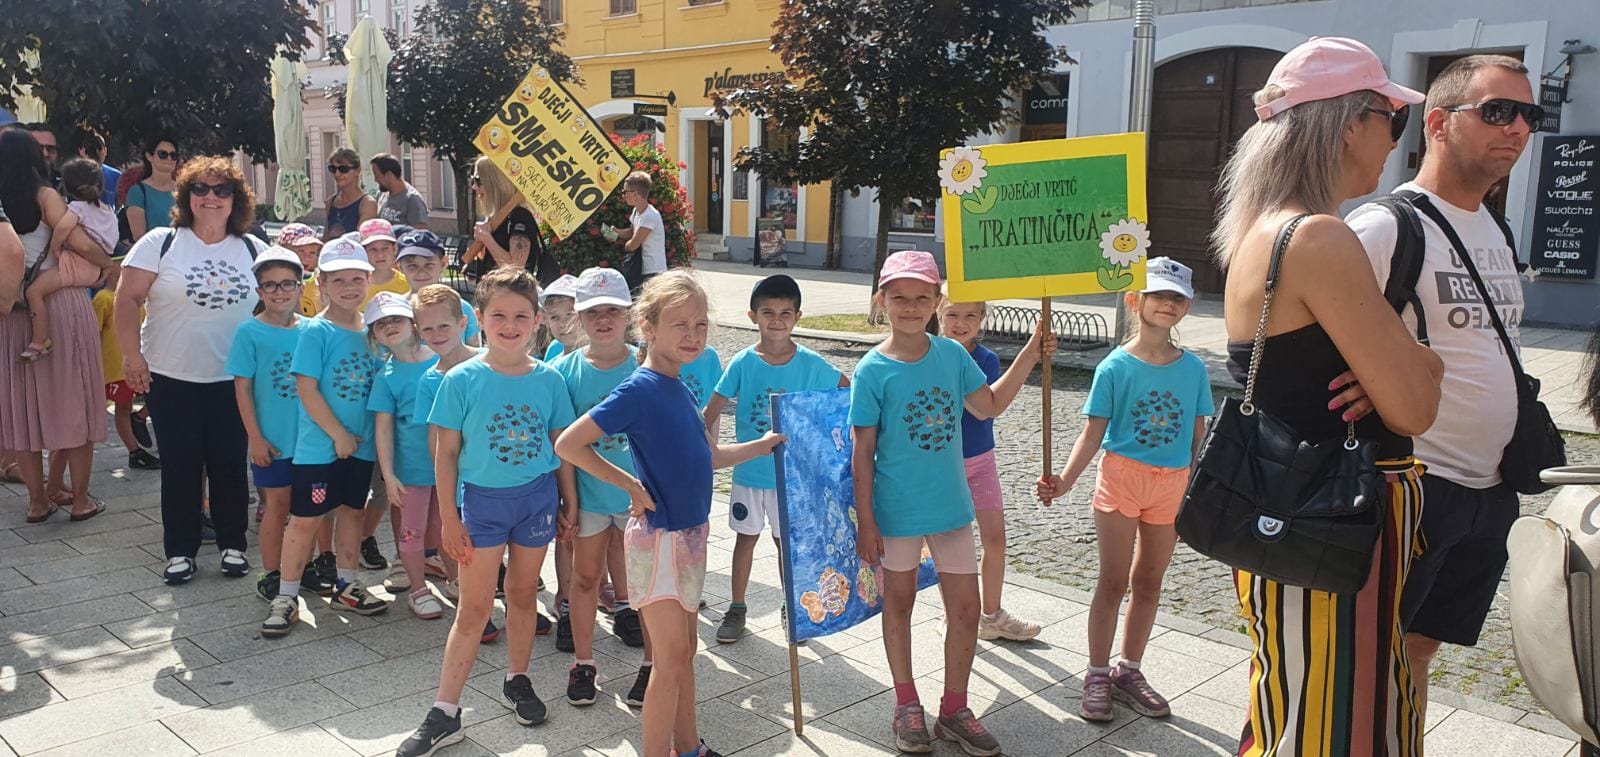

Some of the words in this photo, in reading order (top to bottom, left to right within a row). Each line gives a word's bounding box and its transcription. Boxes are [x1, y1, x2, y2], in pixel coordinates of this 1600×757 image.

[538, 86, 573, 124] DJEČJI
[578, 130, 613, 165] VRTIĆ
[497, 101, 604, 212] SMJEŠKO
[1555, 139, 1595, 158] Ray-Ban
[1555, 170, 1588, 188] Persol
[524, 166, 547, 191] SVETI
[548, 191, 575, 225] MARTIN
[1000, 179, 1040, 202] DJEČJI
[1044, 175, 1078, 197] VRTIĆ
[1547, 190, 1594, 200] VOGUE
[530, 190, 550, 211] MURI
[1544, 205, 1585, 215] swatch
[1546, 226, 1584, 234] NAUTICA
[1547, 239, 1581, 249] GUESS
[1543, 250, 1580, 260] CASIO
[1562, 267, 1588, 276] LEMANS
